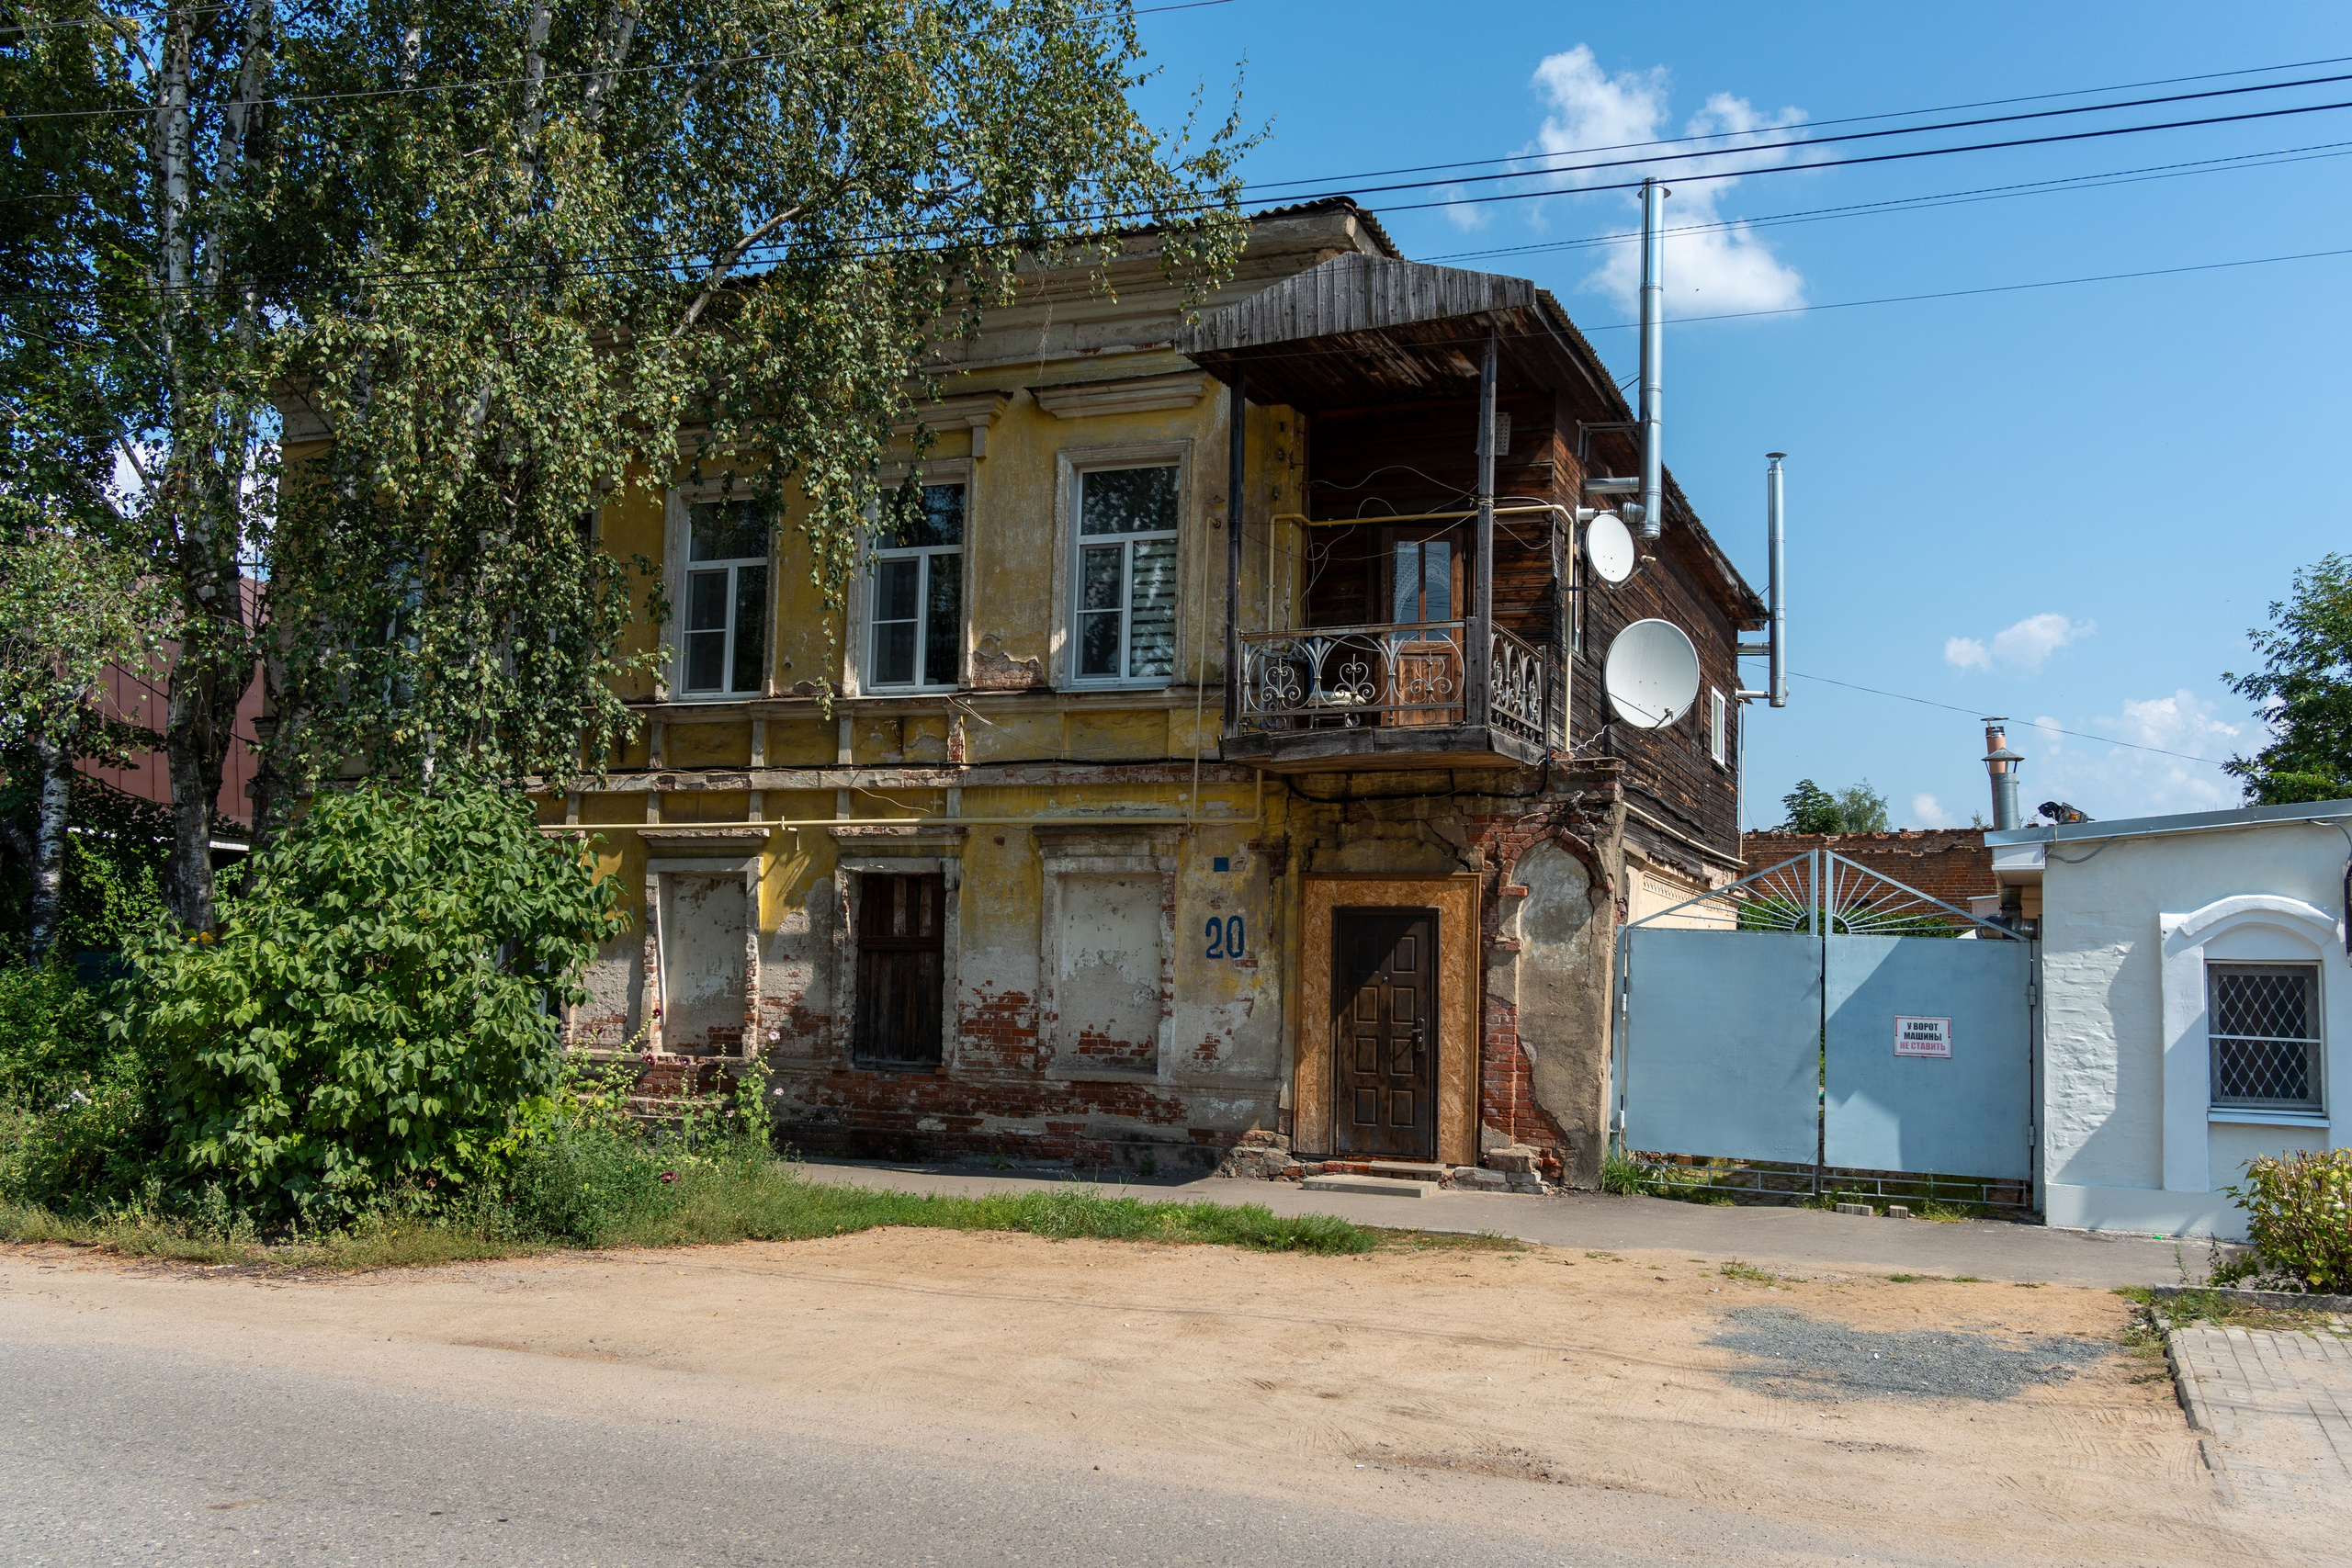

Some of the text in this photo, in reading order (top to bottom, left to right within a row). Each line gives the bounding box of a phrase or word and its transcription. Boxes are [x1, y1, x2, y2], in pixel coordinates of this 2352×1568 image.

[1204, 915, 1244, 959] 20
[1906, 1022, 1939, 1031] У ВОРОТ
[1904, 1032, 1942, 1041] МАШИНЫ
[1911, 1042, 1946, 1051] СТАВИТЬ
